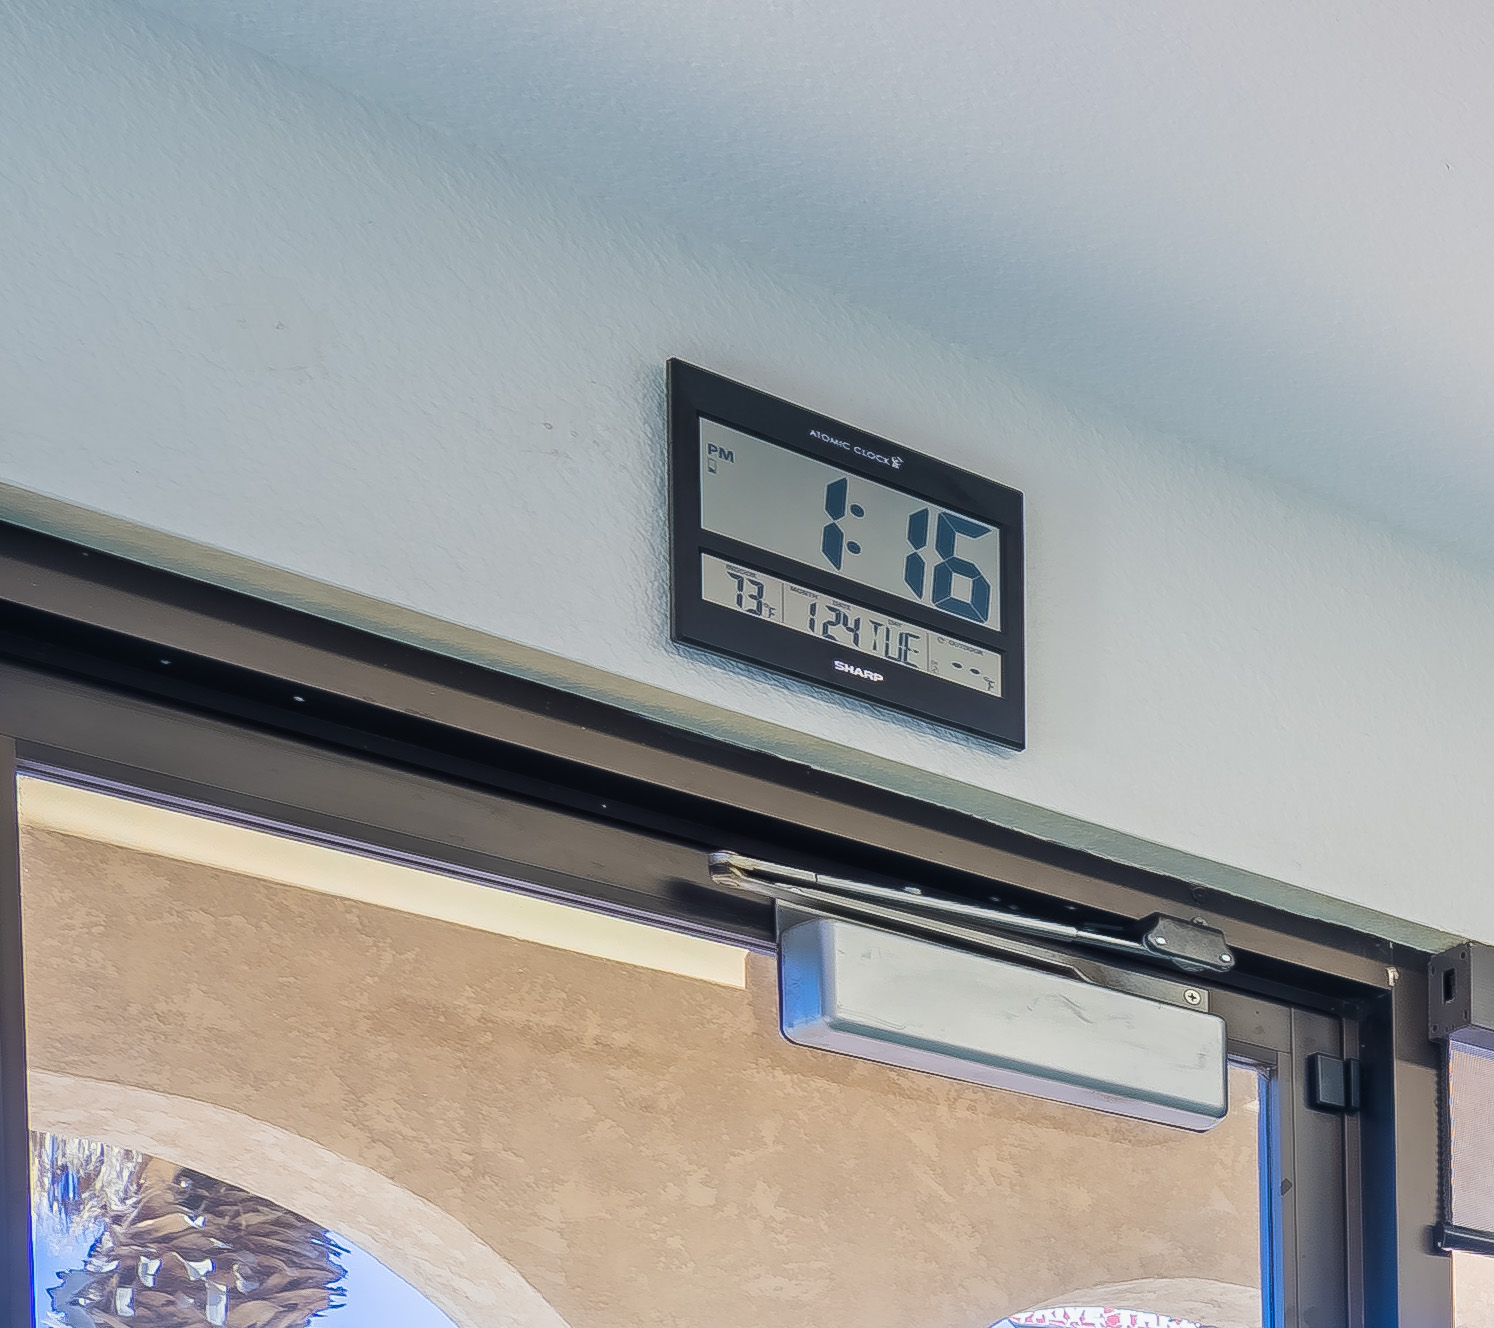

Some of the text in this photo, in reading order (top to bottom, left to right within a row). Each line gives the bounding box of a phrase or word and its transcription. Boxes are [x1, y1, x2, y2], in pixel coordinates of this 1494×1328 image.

[707, 443, 735, 463] PM
[809, 429, 891, 467] ATOMIC CLOCK
[822, 476, 992, 624] 1:16
[869, 619, 922, 669] TUE
[833, 659, 885, 683] SHARP
